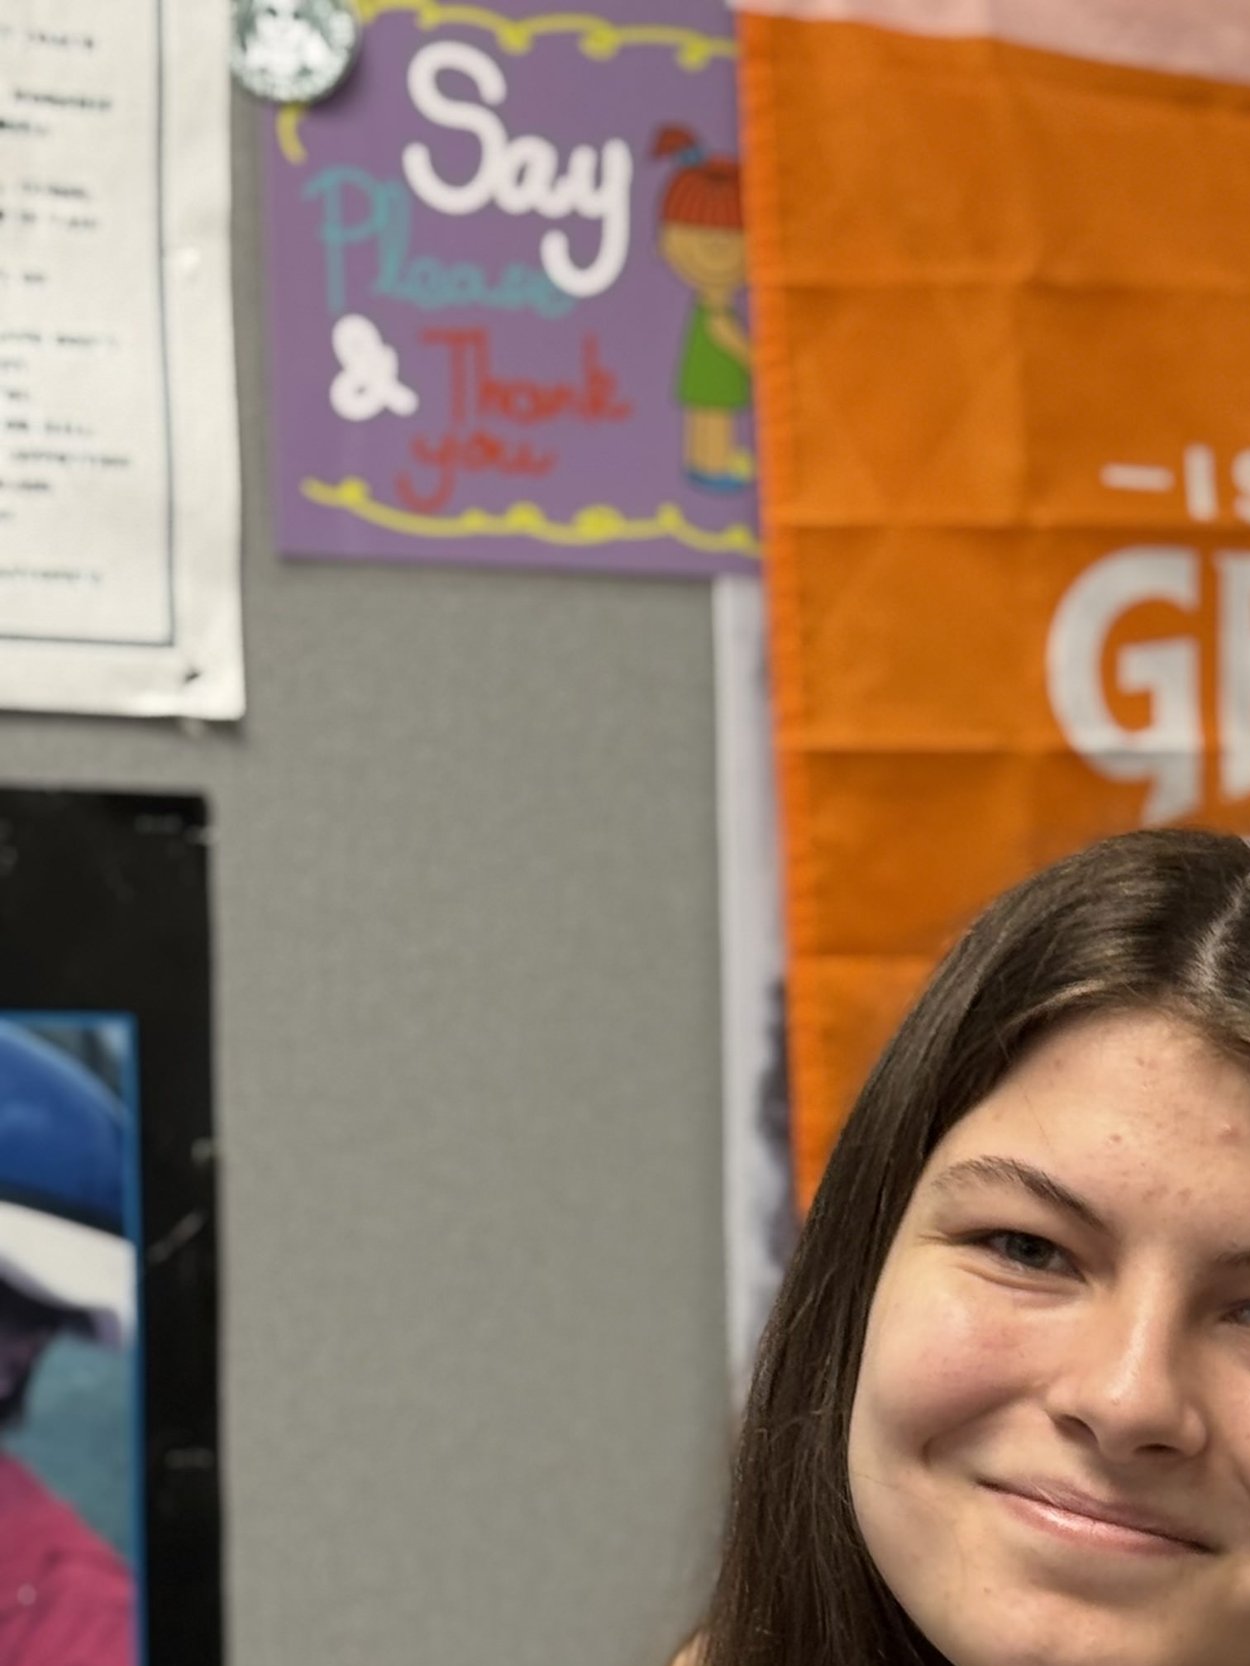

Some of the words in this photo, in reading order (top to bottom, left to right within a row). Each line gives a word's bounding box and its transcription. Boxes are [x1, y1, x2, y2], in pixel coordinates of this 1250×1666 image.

[403, 40, 632, 297] Say
[330, 314, 418, 421] &
[419, 326, 634, 428] Thank
[396, 430, 556, 514] you
[1184, 445, 1217, 522] I
